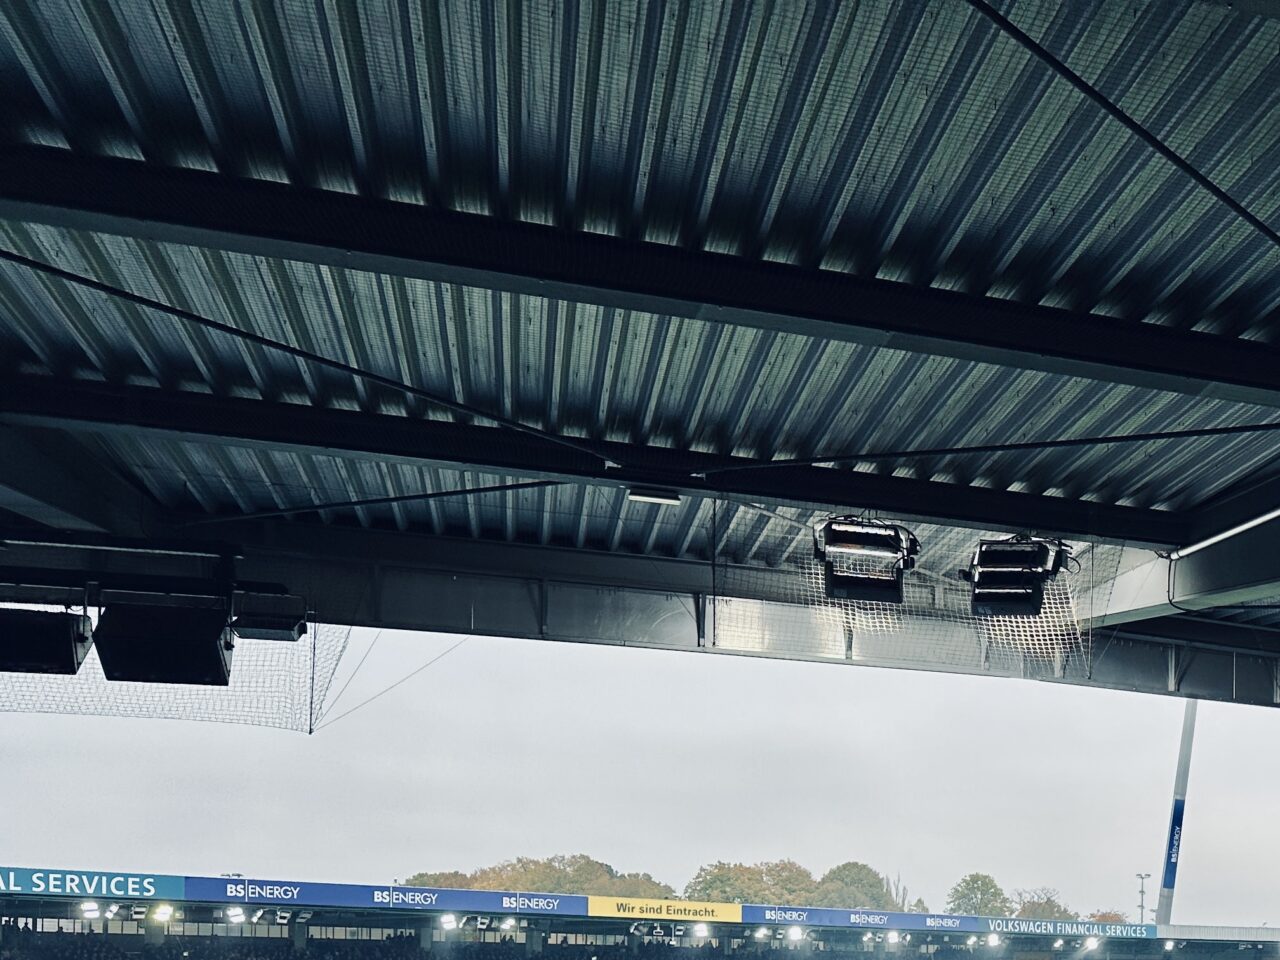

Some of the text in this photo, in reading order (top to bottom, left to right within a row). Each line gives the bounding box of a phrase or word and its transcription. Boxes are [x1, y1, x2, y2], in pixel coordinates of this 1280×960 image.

[31, 872, 156, 896] SERVICES
[616, 902, 718, 917] Wir sind Eintracht.
[988, 919, 1147, 937] VOLKSWAGEN FINANCIAL SERVICES
